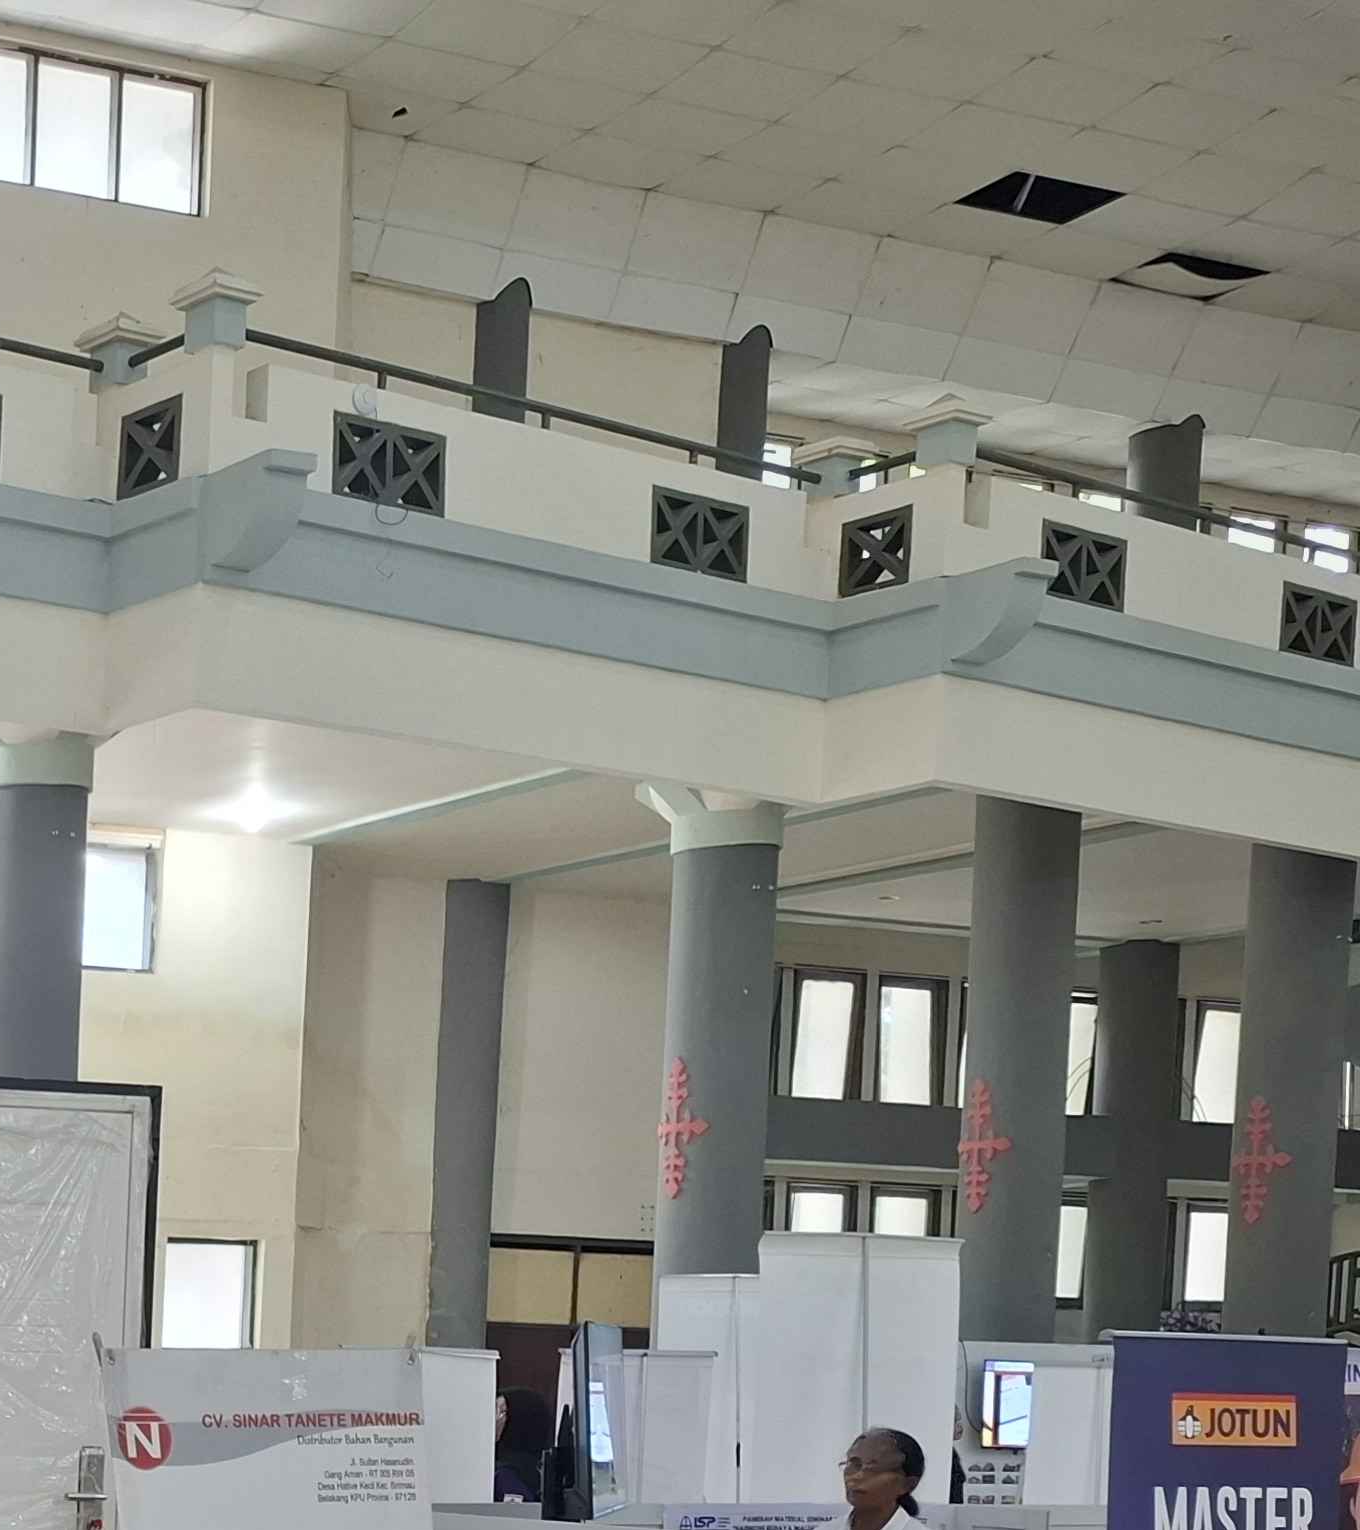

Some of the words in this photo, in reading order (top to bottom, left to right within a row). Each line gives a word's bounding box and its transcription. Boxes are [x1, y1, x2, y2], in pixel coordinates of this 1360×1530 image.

[202, 1413, 229, 1429] CV.
[232, 1413, 281, 1429] SINAR
[284, 1412, 347, 1428] TANETE
[350, 1412, 421, 1427] MAKMUR
[1205, 1407, 1292, 1438] JOTUN
[297, 1434, 343, 1446] Distributor
[345, 1433, 372, 1445] Bahan
[374, 1434, 415, 1447] Bangunan
[359, 1458, 379, 1466] Sultan
[324, 1470, 342, 1480] Gang
[344, 1470, 363, 1478] Aman
[369, 1469, 378, 1478] RT
[392, 1469, 404, 1478] RW
[317, 1482, 335, 1491] Desa
[350, 1493, 366, 1502] KPU
